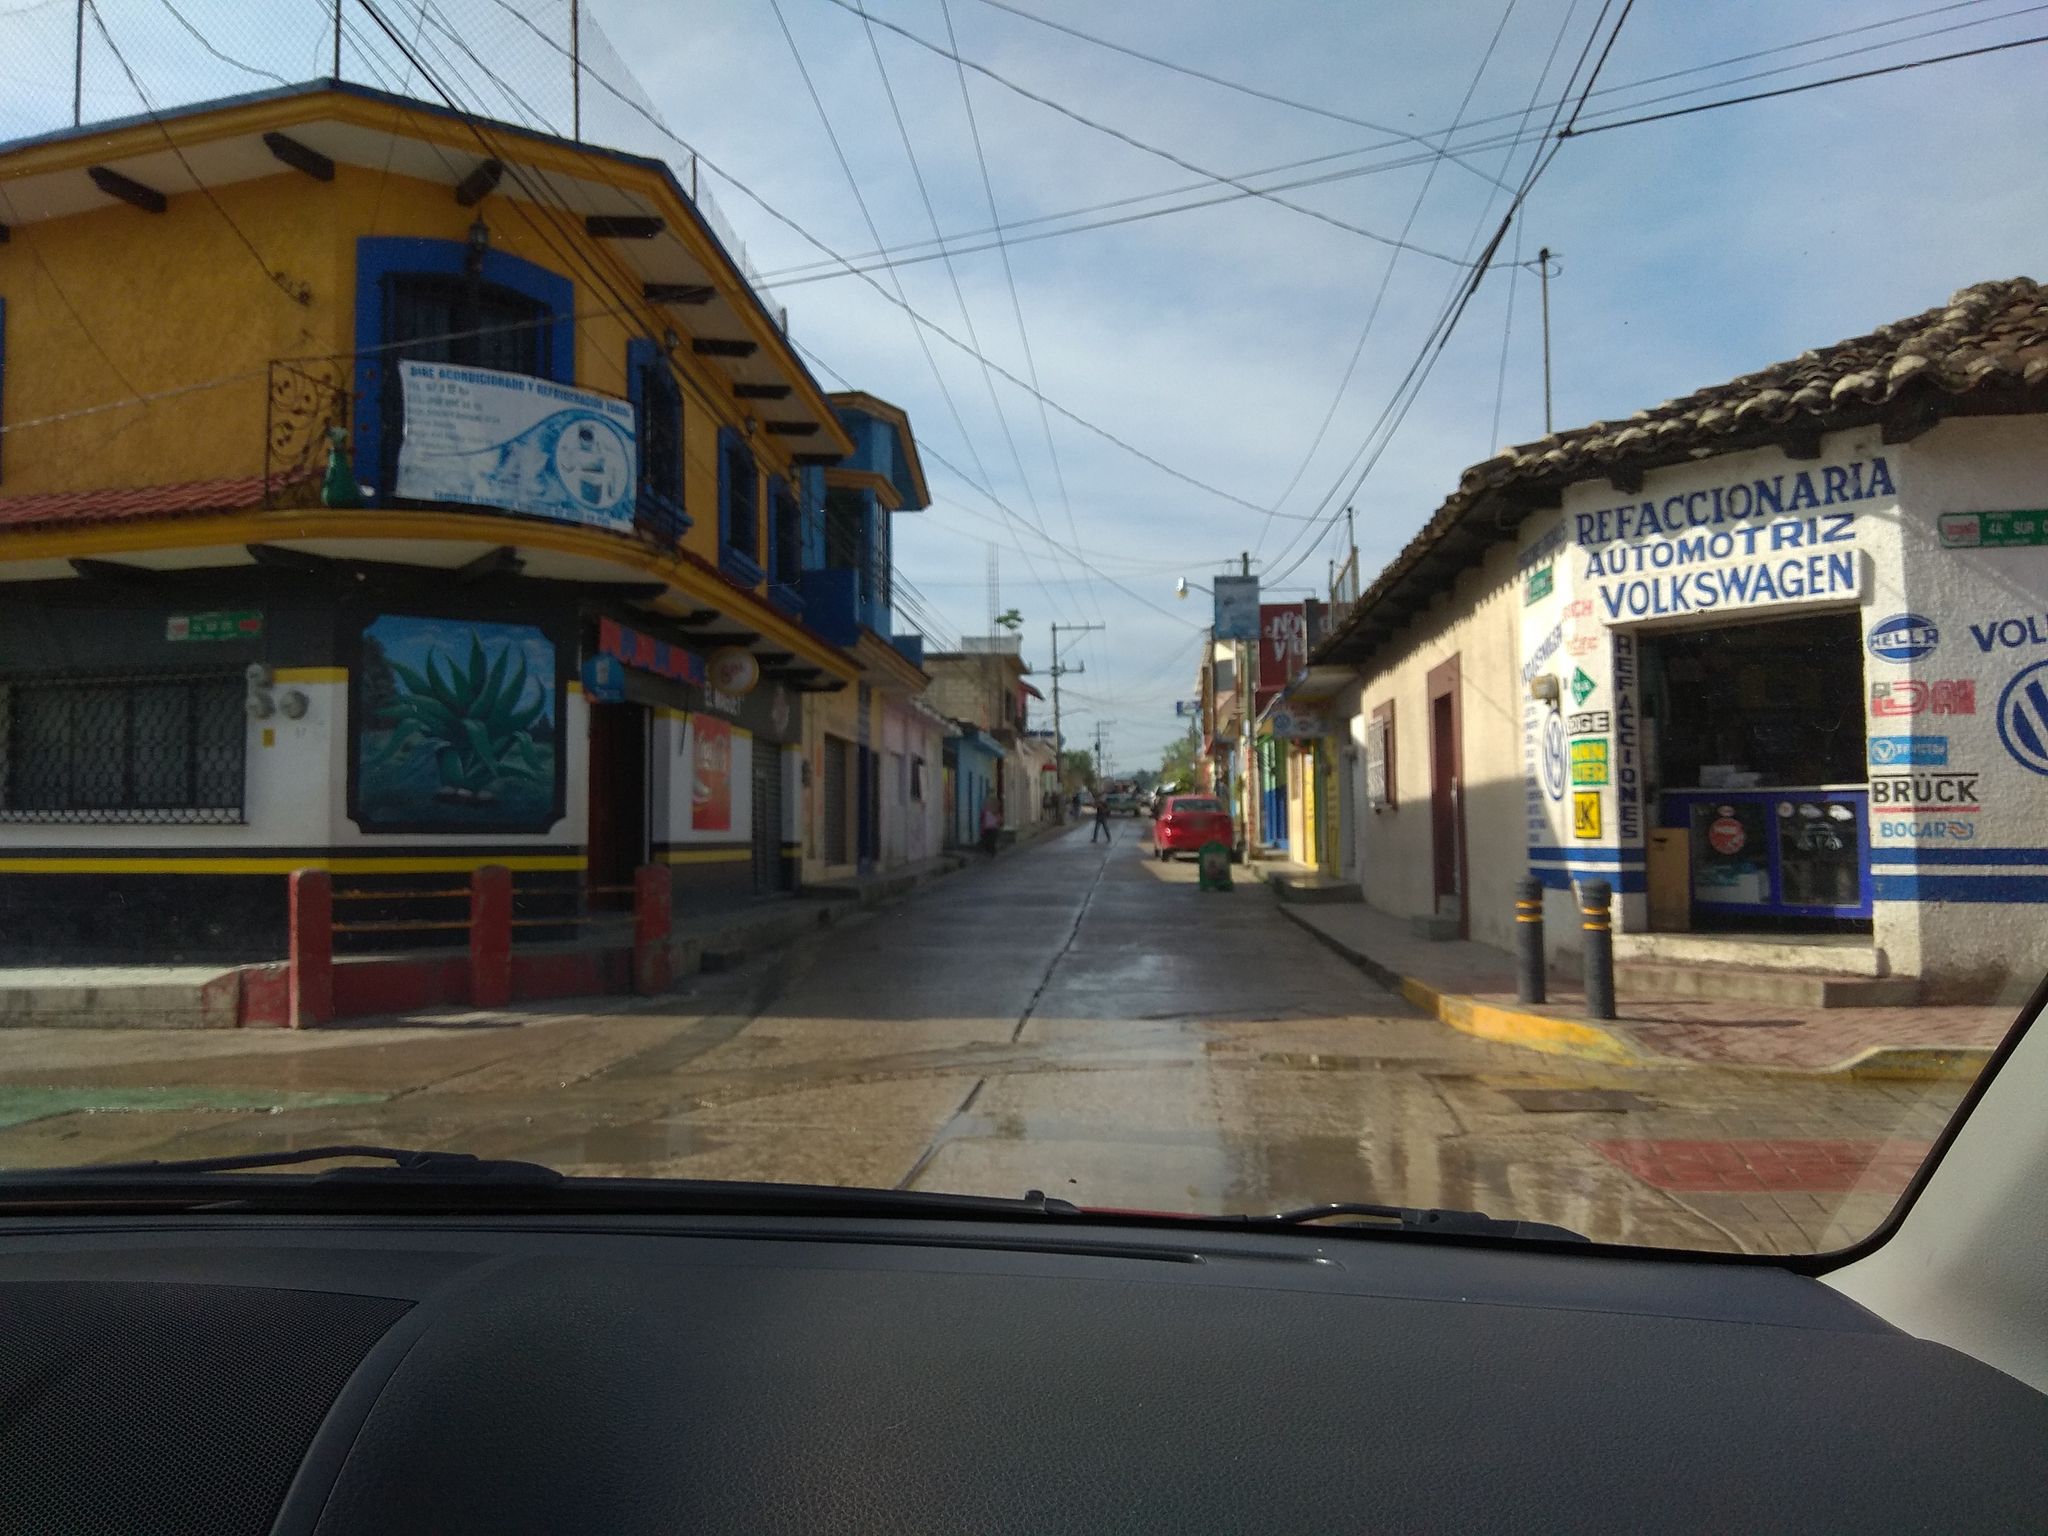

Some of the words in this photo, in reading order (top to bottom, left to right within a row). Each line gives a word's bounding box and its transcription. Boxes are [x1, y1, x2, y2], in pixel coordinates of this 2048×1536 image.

[1575, 456, 1897, 546] REFACCIONARIA
[1584, 512, 1857, 580] AUTOMOTRIZ
[1600, 551, 1855, 619] VOLKSWAGEN
[1870, 625, 1940, 648] HELLA
[1968, 612, 2048, 652] VOL
[1880, 820, 1947, 839] BOCAR
